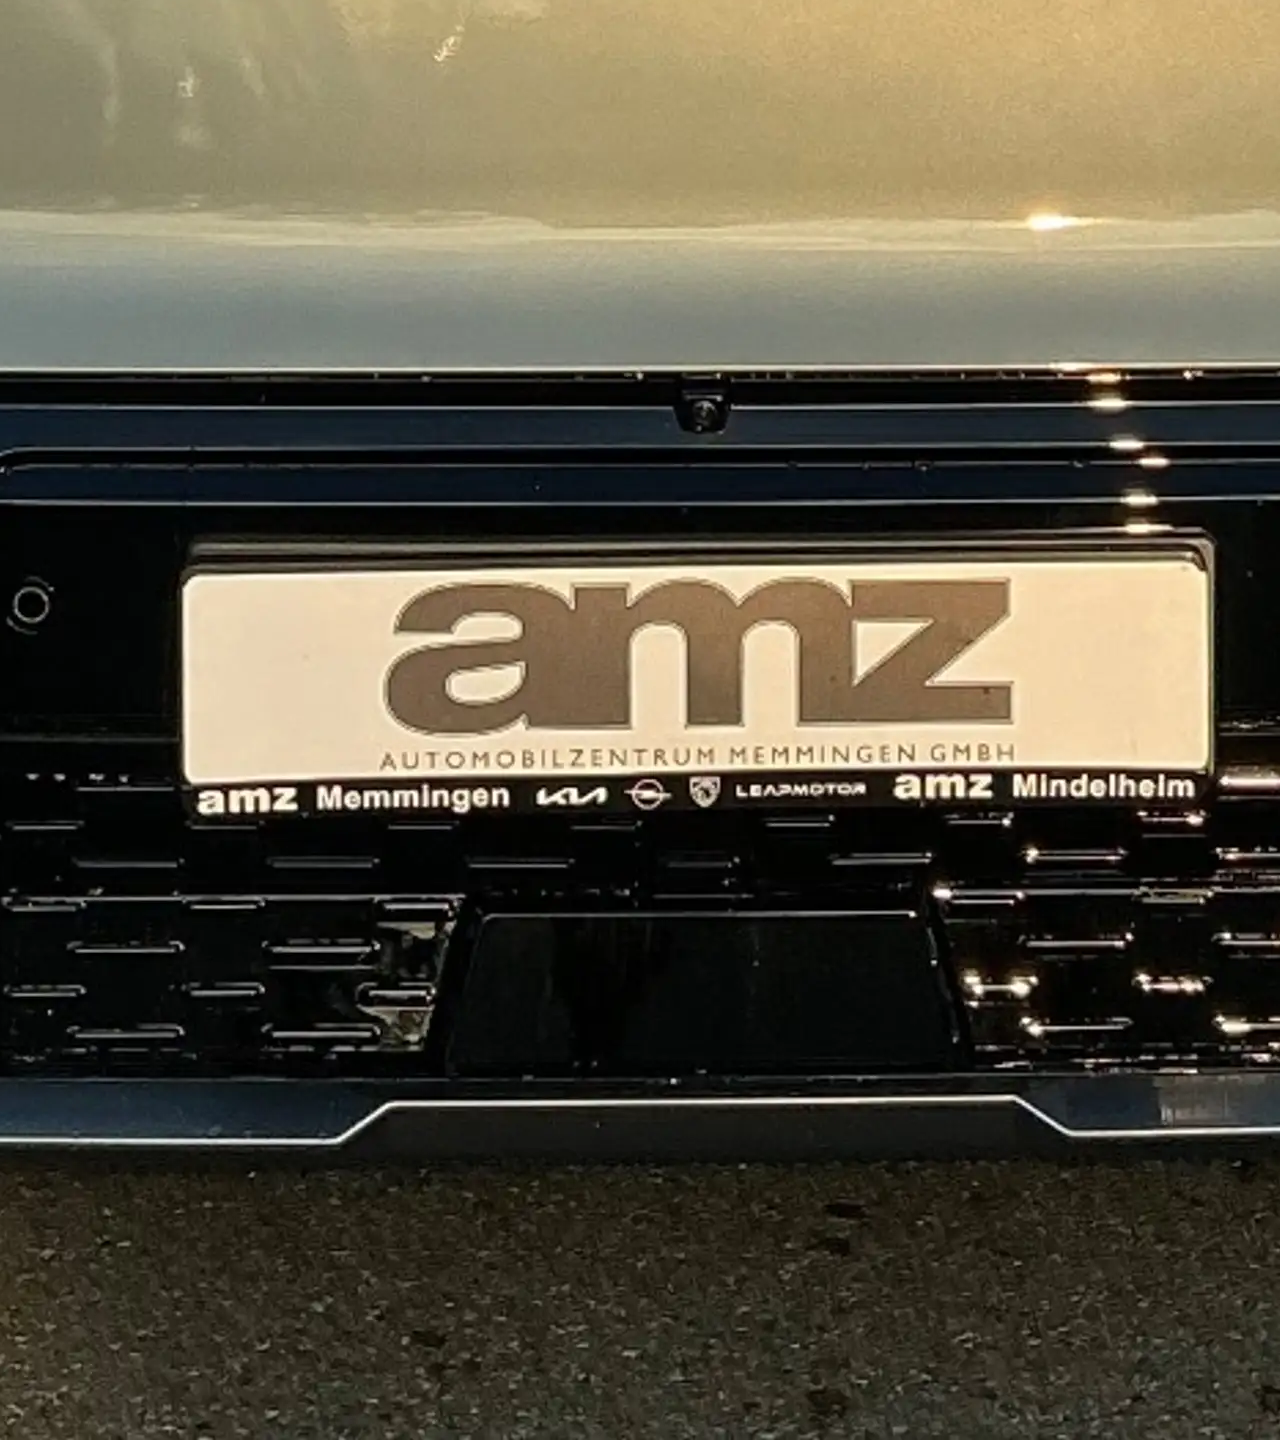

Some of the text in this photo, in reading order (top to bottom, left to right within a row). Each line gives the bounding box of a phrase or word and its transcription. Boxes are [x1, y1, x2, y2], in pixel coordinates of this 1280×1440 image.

[383, 578, 1013, 734] amz
[379, 743, 1015, 771] AUTOMOBILZENTRUM MEMMINGEN GMBH
[197, 773, 1196, 814] amz Memmingen KIA LEAPMOTOR amz Mindelheim
